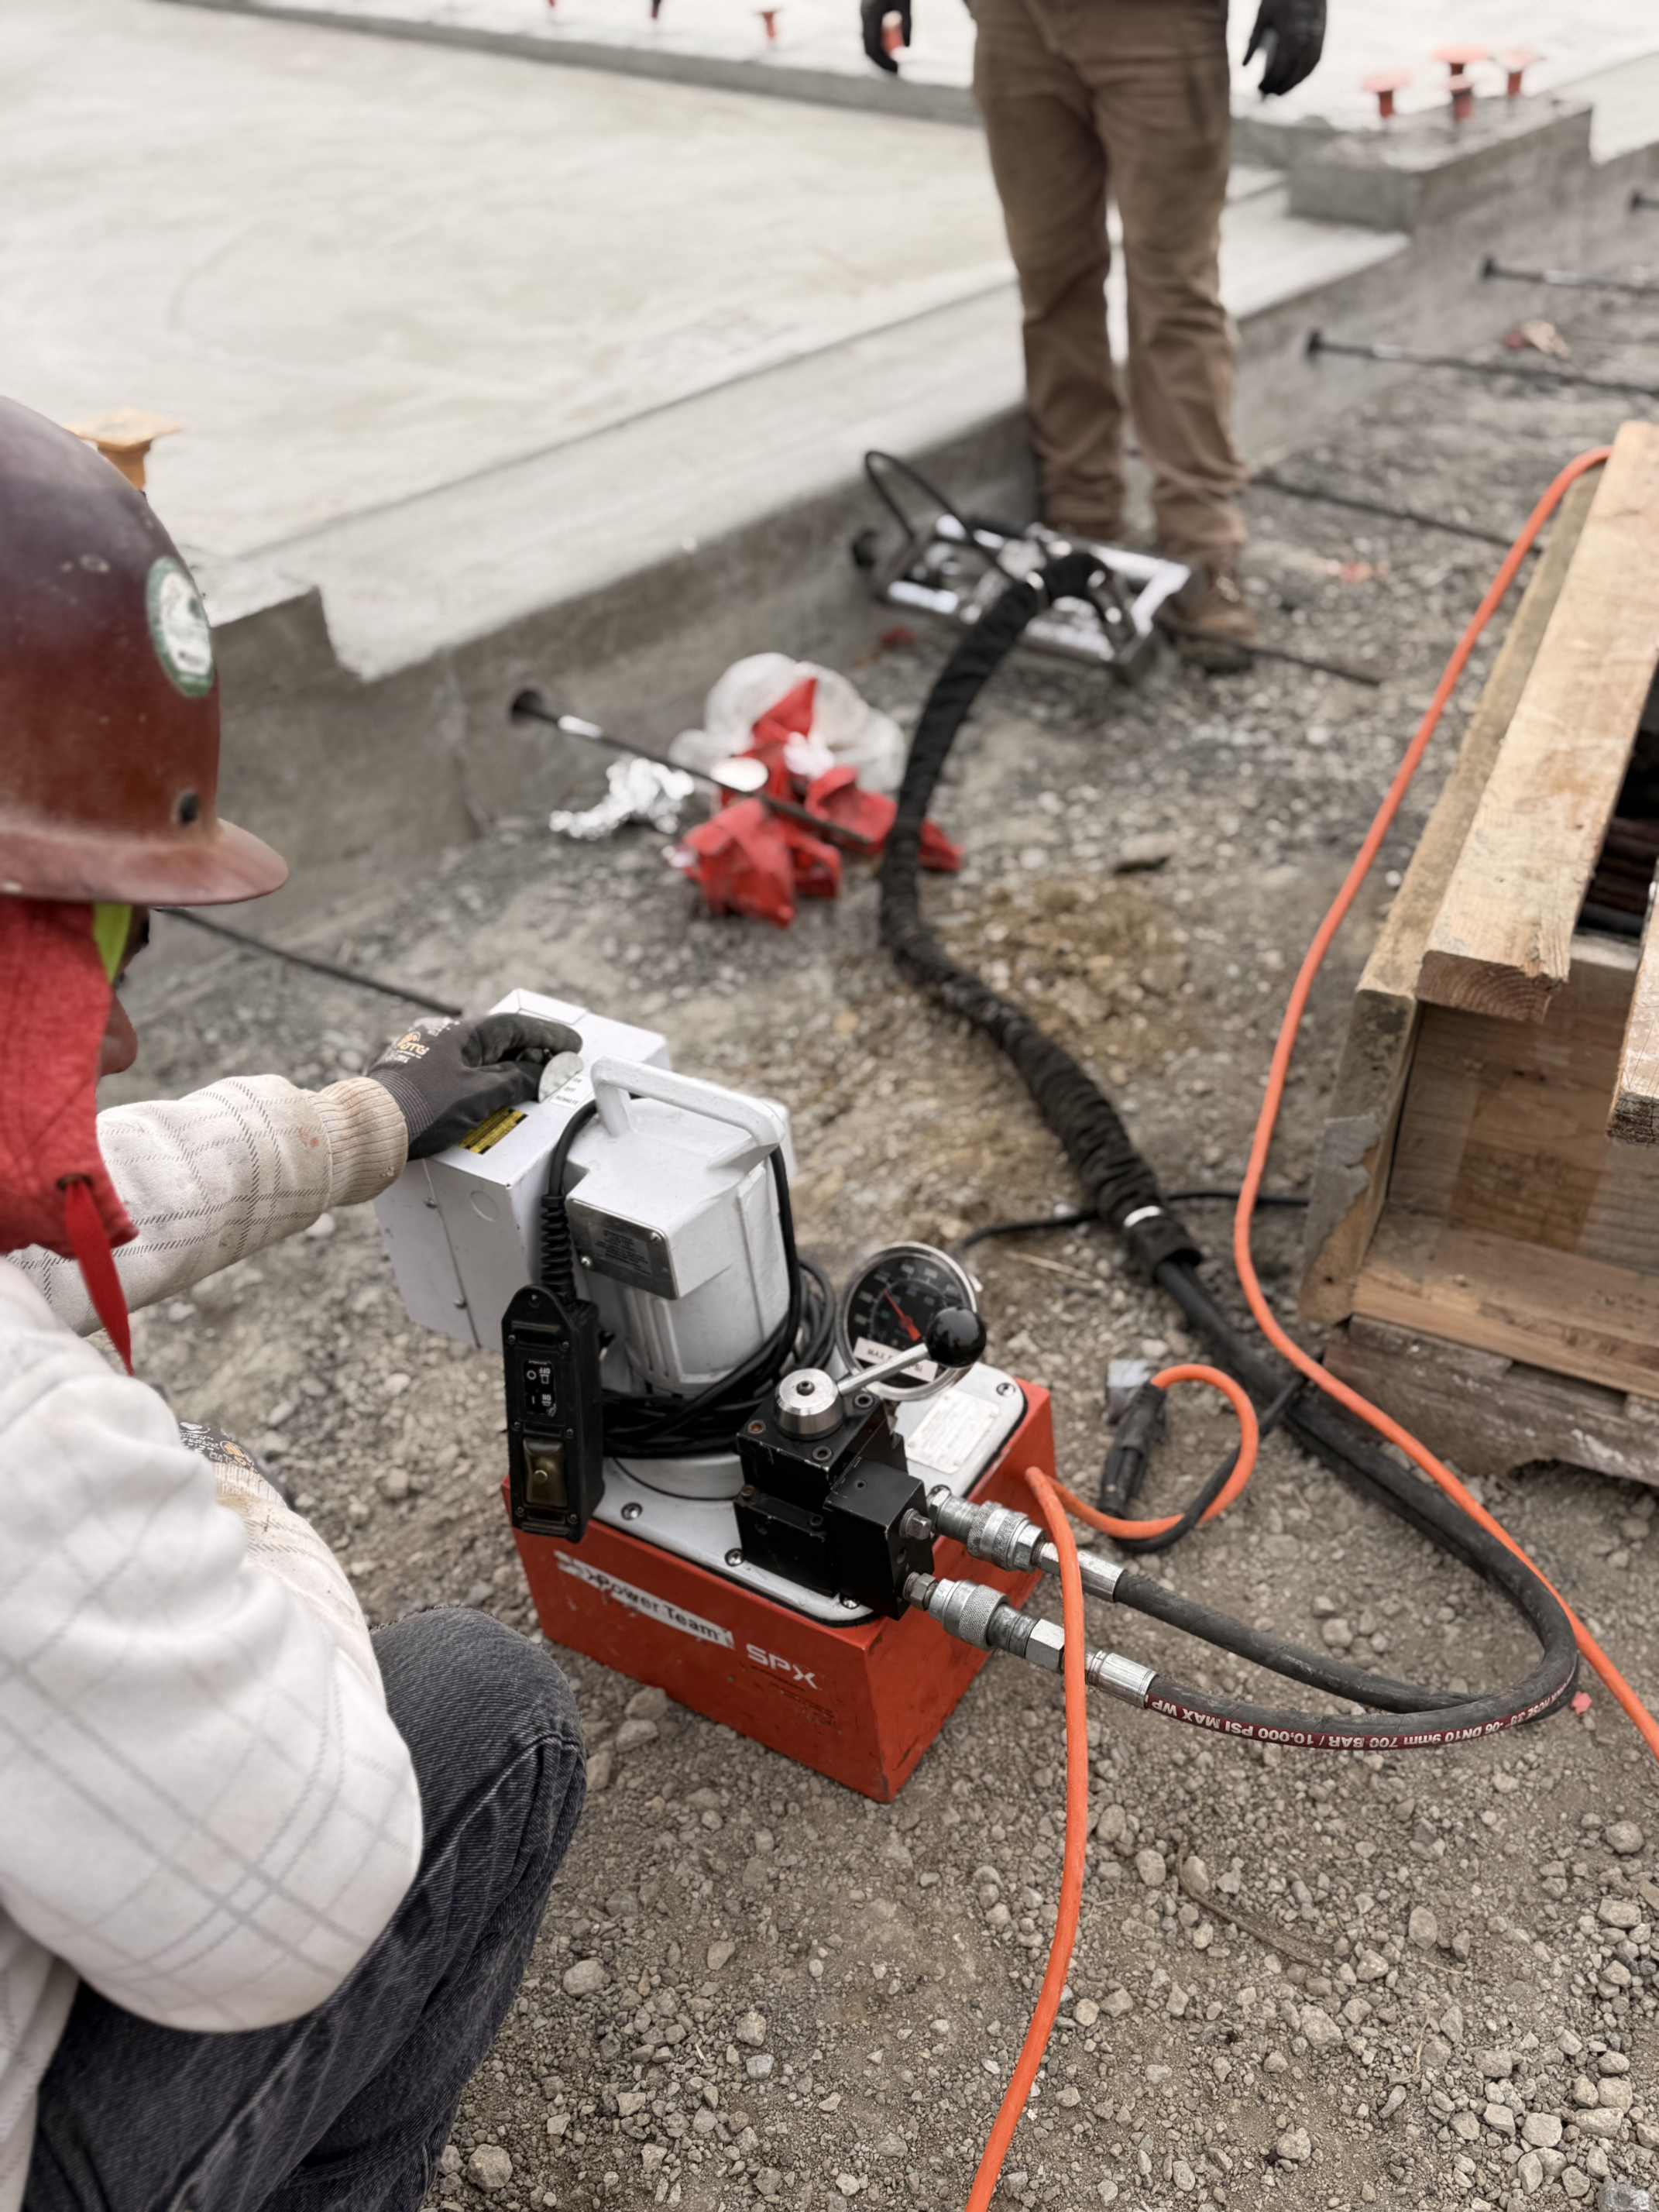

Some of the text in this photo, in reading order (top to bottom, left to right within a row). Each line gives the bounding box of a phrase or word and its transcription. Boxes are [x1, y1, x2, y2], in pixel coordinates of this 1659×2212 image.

[554, 1095, 580, 1105] REMOTE
[664, 1604, 720, 1640] Team
[746, 1644, 818, 1690] SPX
[1152, 1700, 1177, 1717] WP
[1182, 1708, 1221, 1729] MAX
[1225, 1721, 1253, 1737] PSI
[1444, 1726, 1482, 1742] DN10
[1485, 1721, 1504, 1734] -06
[1258, 1727, 1314, 1745] 10,000
[1318, 1736, 1325, 1746] /
[1328, 1736, 1365, 1748] BAR
[1369, 1736, 1398, 1748] 700
[1403, 1734, 1441, 1745] 9mm
